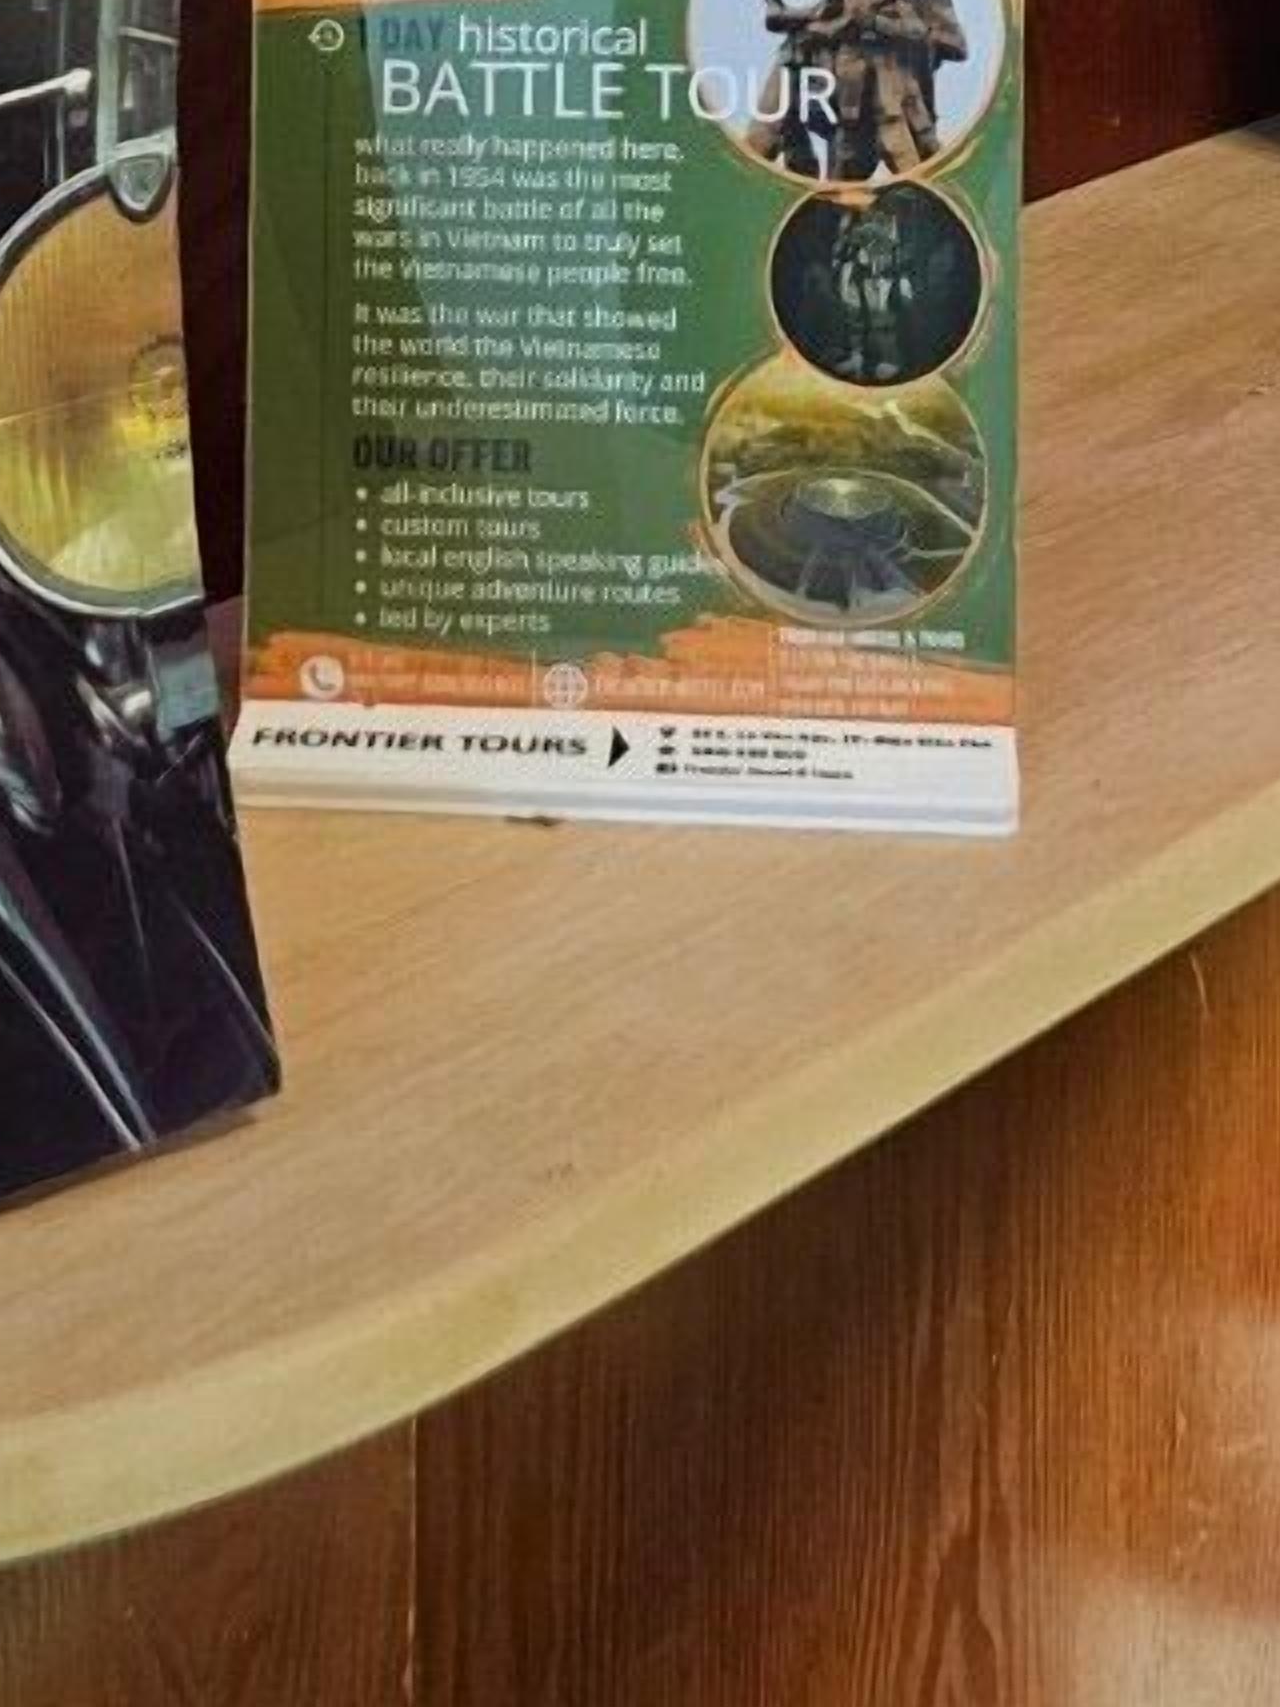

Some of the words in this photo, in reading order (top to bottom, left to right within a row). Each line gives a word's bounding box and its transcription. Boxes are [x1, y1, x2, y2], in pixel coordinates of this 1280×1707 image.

[380, 15, 445, 53] DAY
[458, 14, 648, 57] historical
[381, 59, 627, 121] BATTLE
[643, 63, 842, 125] TOUR
[492, 135, 616, 165] happened
[511, 170, 558, 189] was
[354, 195, 477, 224] significant
[483, 195, 554, 220] battle
[559, 197, 585, 221] of
[623, 199, 665, 223] the
[447, 226, 546, 253] Vietnam
[553, 232, 577, 253] to
[354, 258, 394, 280] the
[400, 258, 540, 284] Vietnamese
[547, 260, 632, 288] people
[376, 306, 422, 325] was
[476, 306, 520, 327] war
[527, 304, 576, 328] that
[583, 301, 677, 332] showed
[352, 334, 393, 356] the
[519, 336, 662, 360] Vietnamese
[479, 366, 537, 390] their
[659, 371, 706, 393] and
[352, 395, 408, 419] their
[415, 397, 610, 424] underestimated
[353, 433, 418, 470] OUR
[429, 437, 533, 473] OFFER
[528, 488, 590, 509] tours
[381, 515, 470, 537] custom
[476, 516, 542, 539] tours
[380, 540, 437, 568] local
[443, 545, 531, 575] english
[536, 550, 644, 580] speaking
[381, 580, 465, 603] unique
[470, 580, 596, 604] adventure
[603, 584, 682, 605] routes
[379, 608, 418, 630] led
[424, 603, 453, 637] by
[458, 612, 552, 636] experts
[252, 727, 449, 753] FRONTIER
[459, 735, 588, 755] TOURS
